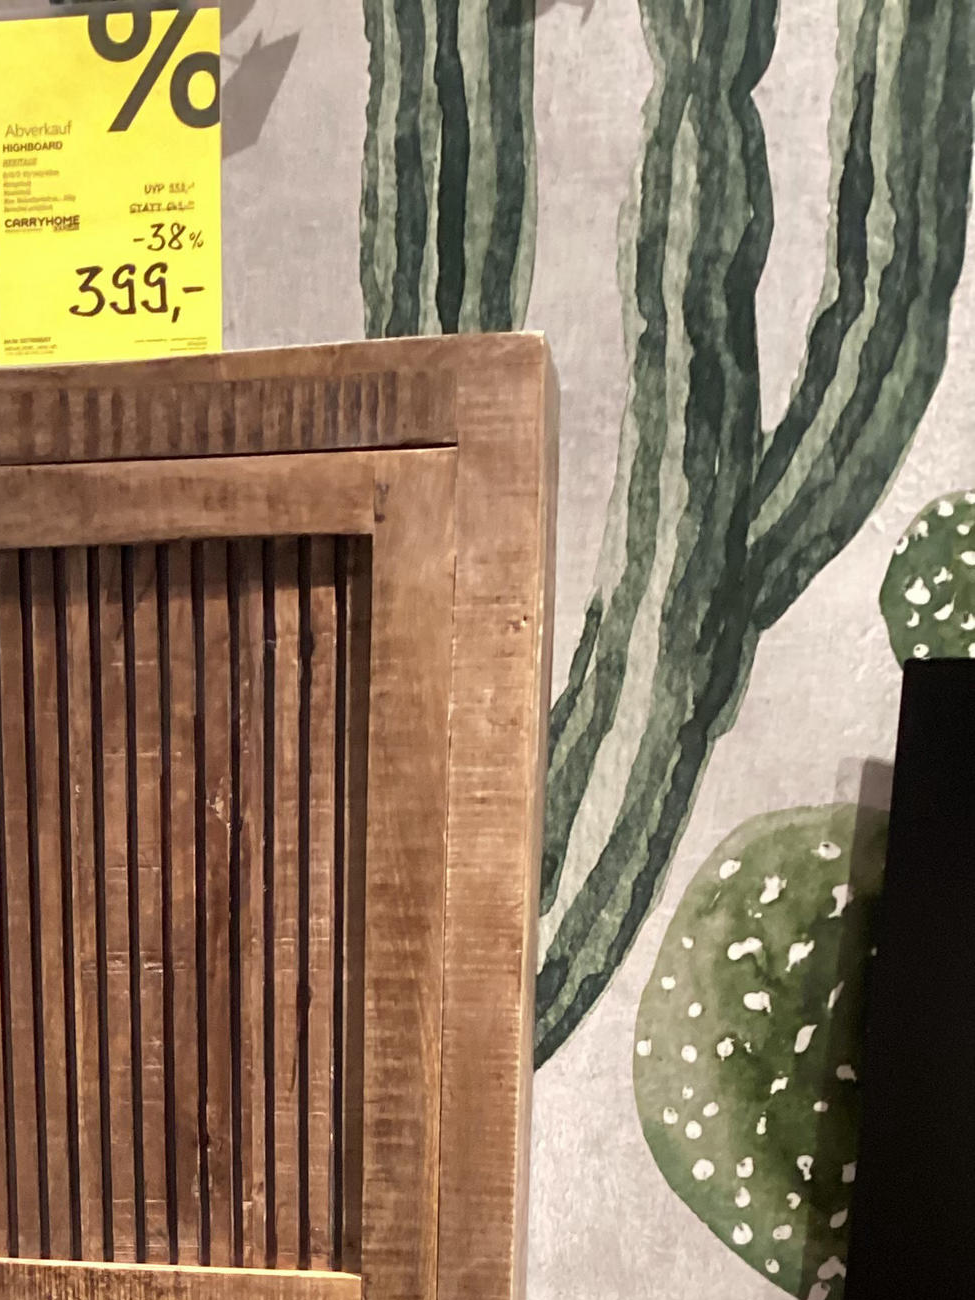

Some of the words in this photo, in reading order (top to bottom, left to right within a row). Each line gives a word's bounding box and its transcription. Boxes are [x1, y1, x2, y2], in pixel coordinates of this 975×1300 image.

[4, 120, 72, 138] Abverkauf
[2, 141, 63, 153] HIGHBOARD
[4, 215, 80, 229] CARRYHOME
[69, 261, 205, 323] 399,-
